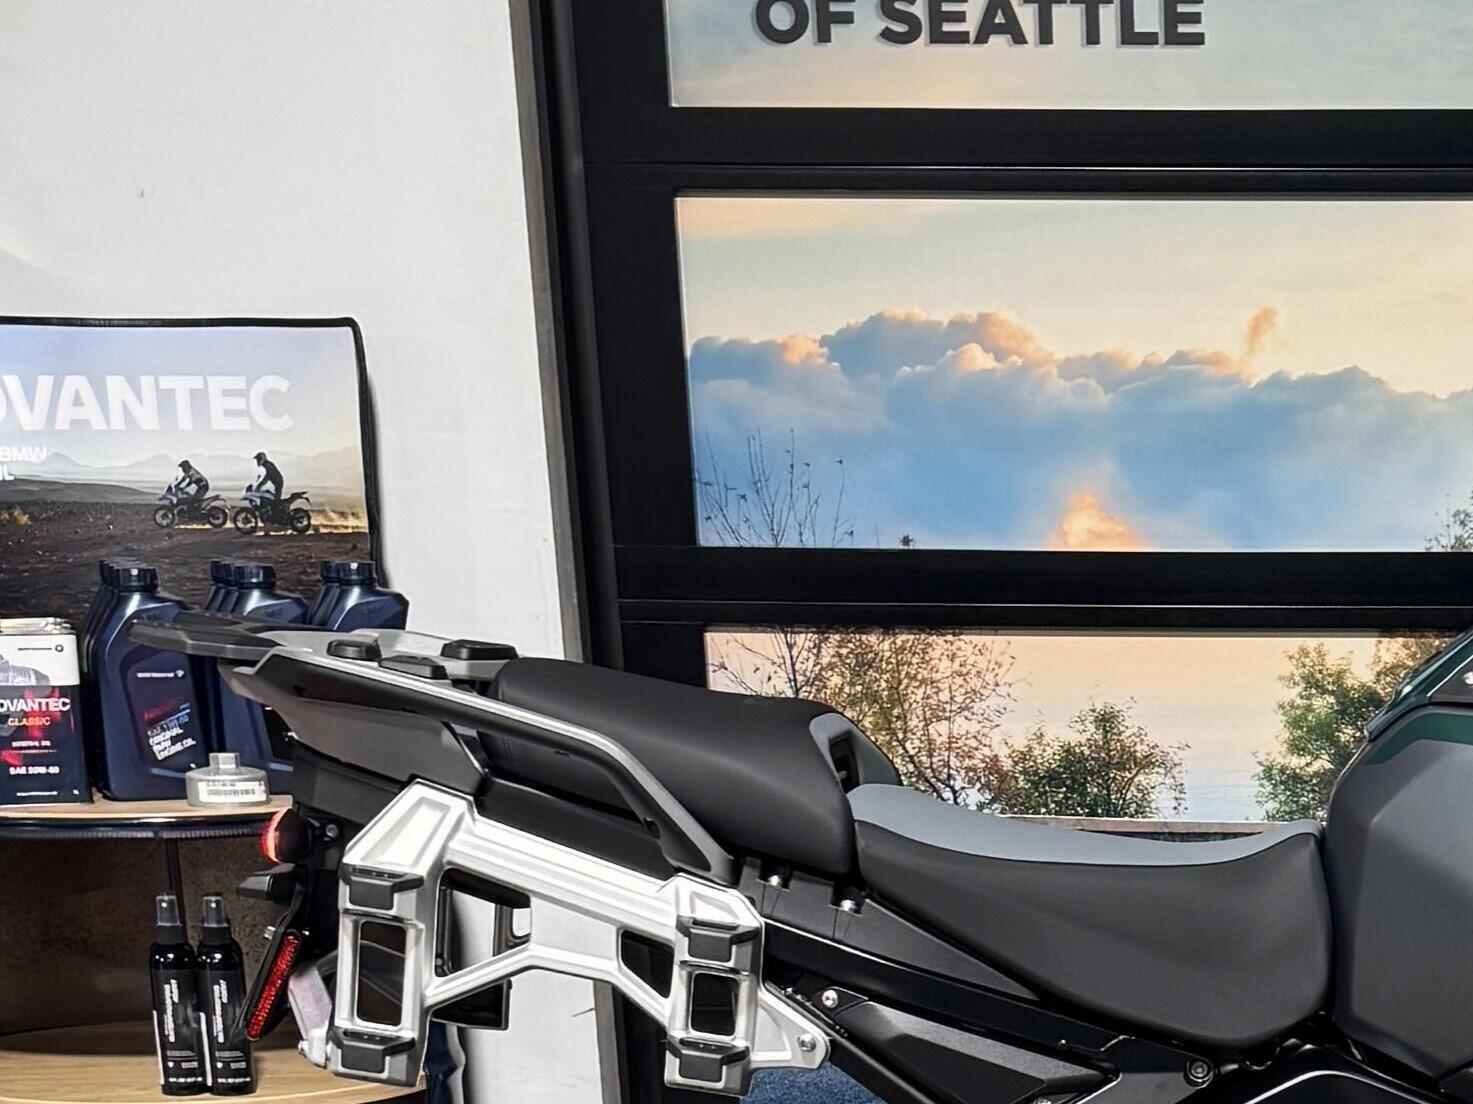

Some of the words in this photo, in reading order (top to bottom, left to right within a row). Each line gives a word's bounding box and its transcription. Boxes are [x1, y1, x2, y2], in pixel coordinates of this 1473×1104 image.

[755, 0, 855, 45] OF
[879, 0, 1206, 46] SEATTLE
[0, 374, 294, 432] VANTEC
